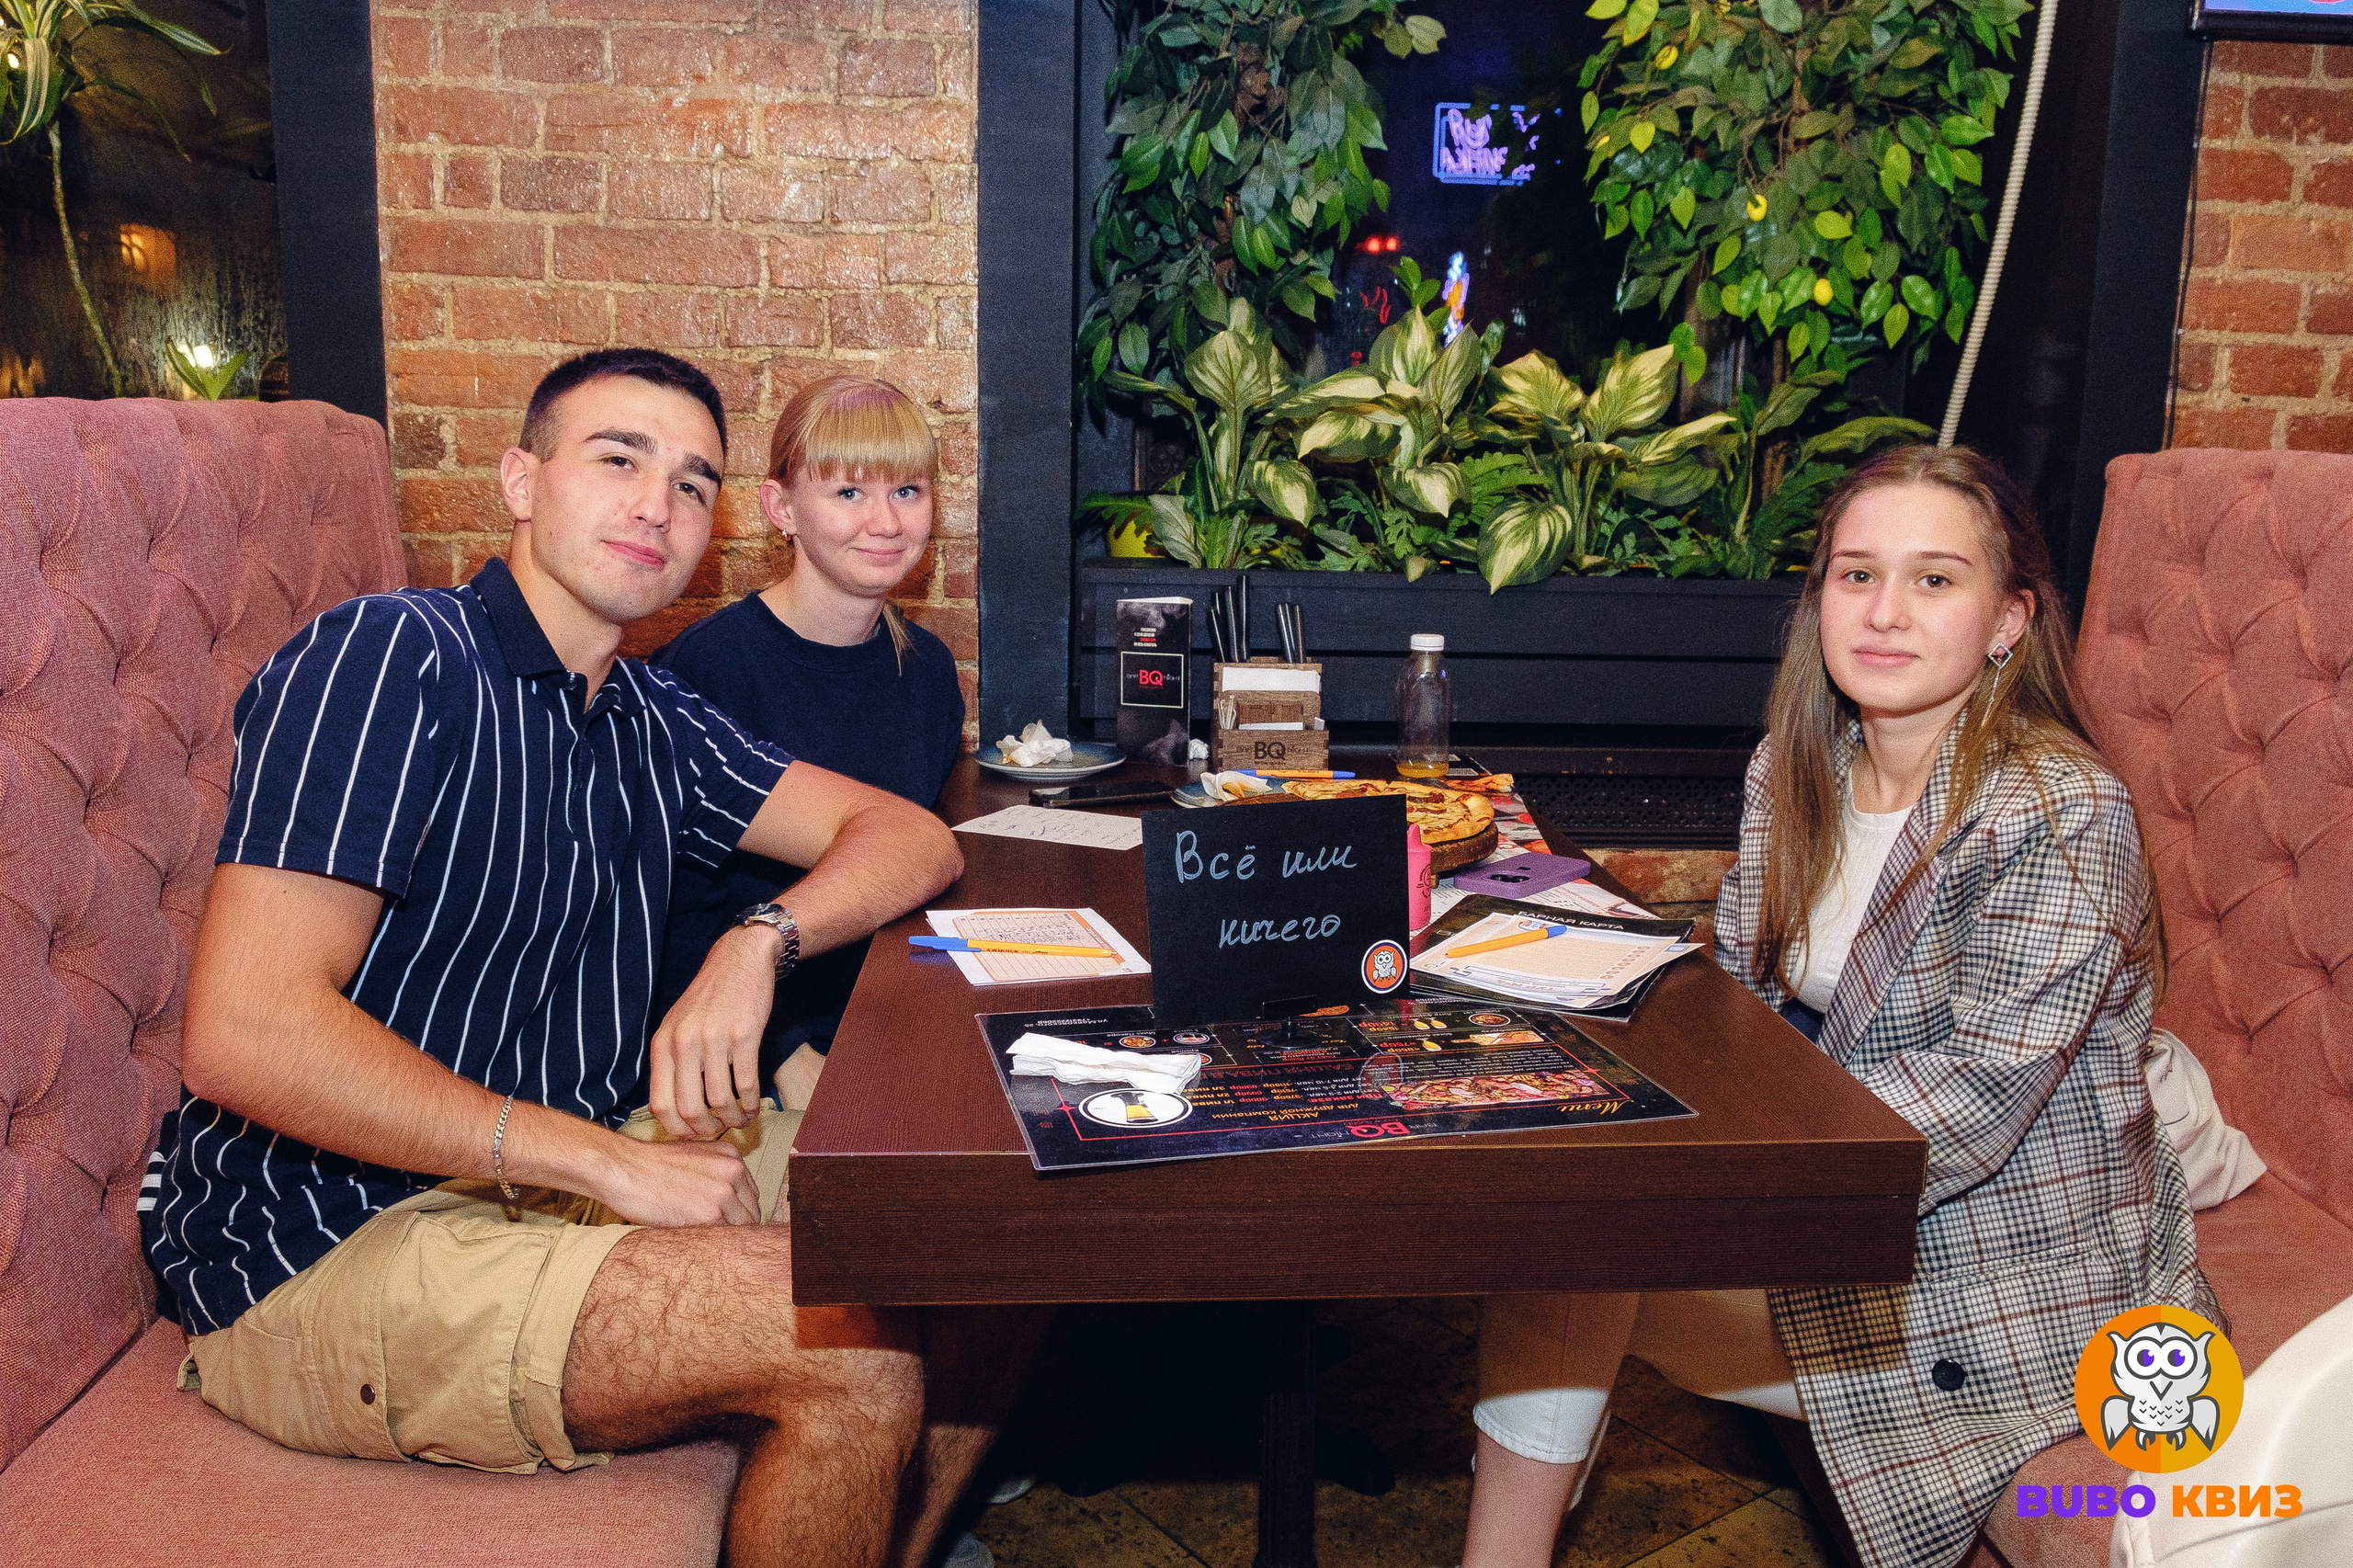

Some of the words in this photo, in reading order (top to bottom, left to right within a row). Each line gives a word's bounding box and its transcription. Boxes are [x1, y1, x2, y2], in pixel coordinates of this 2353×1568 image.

[1139, 669, 1163, 686] BQ
[1254, 741, 1286, 760] BQ
[1175, 830, 1256, 884] Всё
[1281, 845, 1358, 878] или
[1518, 911, 1576, 925] БАРНАЯ
[1579, 920, 1624, 930] КАРТА
[1218, 914, 1341, 949] ничего
[1224, 1066, 1281, 1079] ПИВА
[1283, 1062, 1354, 1074] БАШНЯ
[1211, 1110, 1277, 1119] компании
[1267, 1111, 1319, 1121] АКЦИЯ
[1279, 1105, 1335, 1115] дружной
[1556, 1099, 1632, 1116] Menu
[1345, 1121, 1410, 1138] BQ
